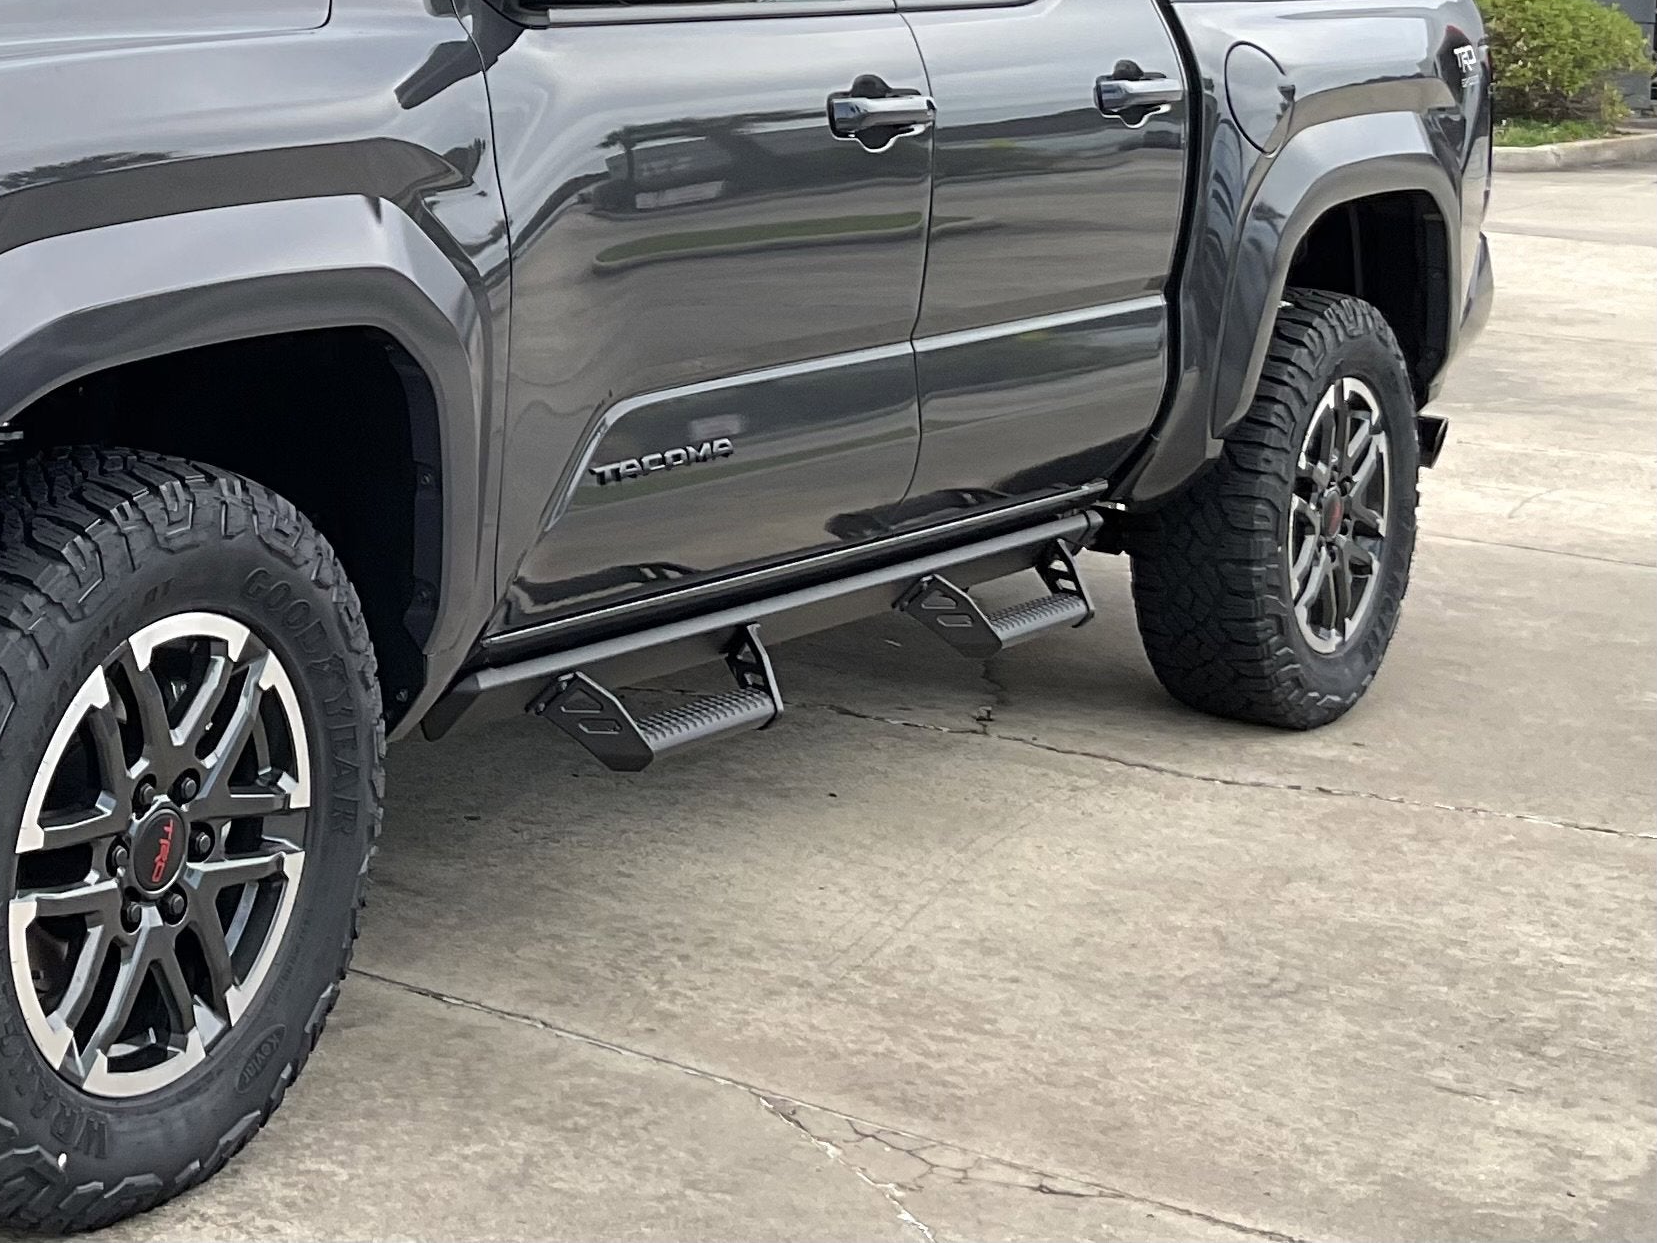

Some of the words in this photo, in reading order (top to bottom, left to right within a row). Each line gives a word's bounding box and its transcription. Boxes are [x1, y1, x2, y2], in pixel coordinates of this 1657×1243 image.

[1453, 44, 1477, 73] TRD
[589, 436, 735, 486] TACOMA
[244, 566, 361, 835] GOODYEAR
[151, 818, 175, 883] TRD
